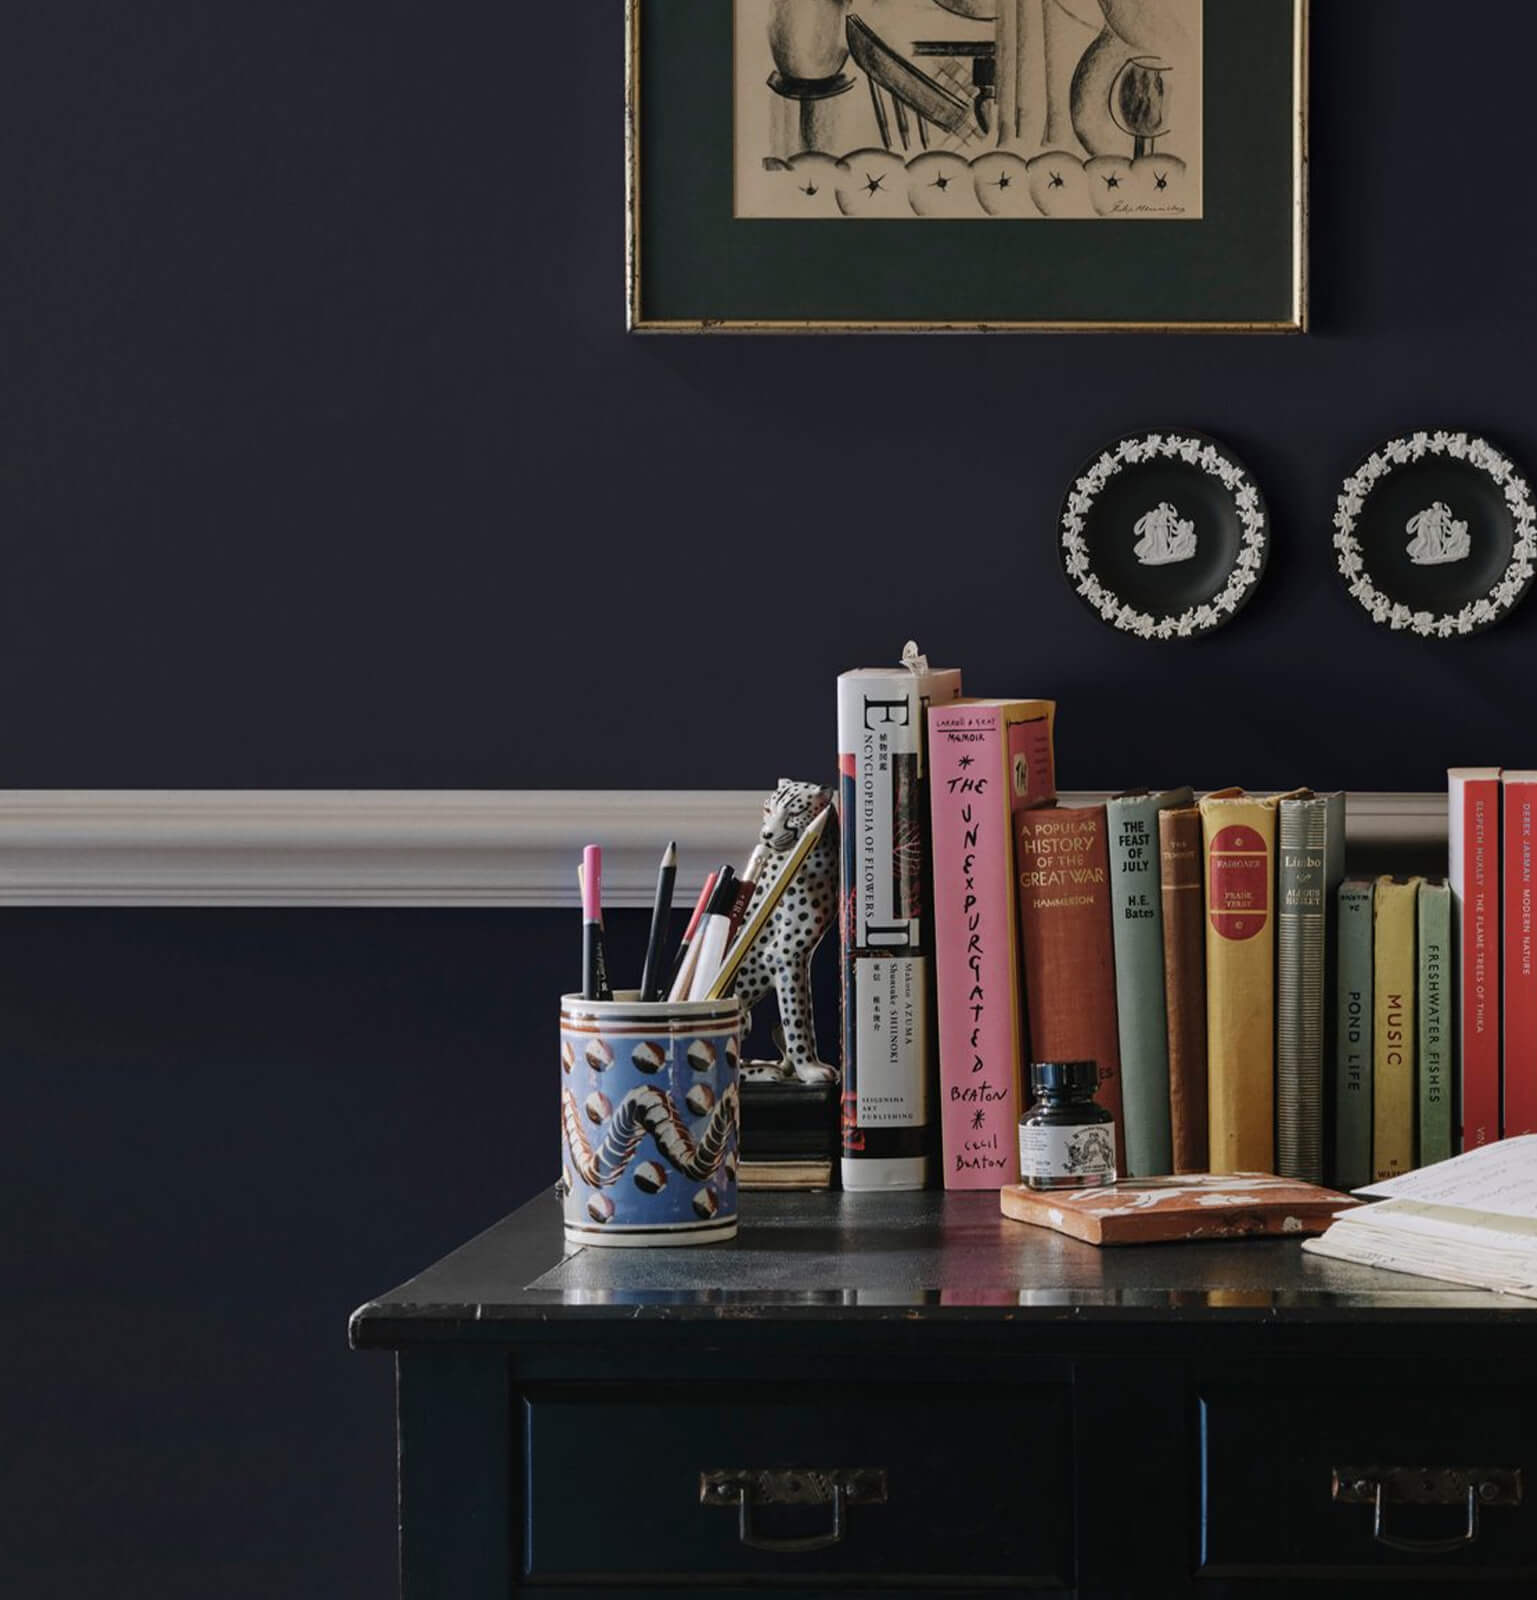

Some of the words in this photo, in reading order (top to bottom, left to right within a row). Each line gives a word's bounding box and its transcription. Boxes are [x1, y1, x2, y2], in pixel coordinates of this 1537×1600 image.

[947, 733, 985, 743] MEMOIR
[947, 777, 988, 795] THE
[1021, 825, 1032, 837] A
[1034, 821, 1097, 836] POPULAR
[1123, 821, 1145, 833] THE
[1475, 800, 1485, 843] ELSPETH
[1522, 802, 1531, 836] DEREK
[864, 836, 874, 853] OF
[1024, 836, 1095, 855] HISTORY
[1119, 833, 1151, 847] FEAST
[1127, 848, 1143, 859] OF
[1036, 856, 1053, 869] OF
[1057, 855, 1084, 867] THE
[1122, 860, 1149, 873] JULY
[1284, 855, 1321, 868] Limbo
[1475, 847, 1485, 886] HUXLEY
[1522, 840, 1531, 882] JARMAN
[864, 857, 874, 919] FLOWERS
[1020, 869, 1068, 888] GREAT
[1070, 867, 1105, 884] WAR
[1033, 895, 1095, 909] HAMMERTON
[1124, 908, 1155, 920] Bates
[1128, 894, 1150, 907] H.E.
[1475, 893, 1485, 913] THE
[1522, 888, 1531, 932] MODERN
[961, 803, 984, 1073] UNEXPURGATED
[1475, 916, 1485, 949] FLAME
[1475, 952, 1485, 983] TREES
[1522, 936, 1531, 976] NATURE
[889, 963, 898, 1006] Shunsuke
[905, 963, 913, 998] Makoto
[1428, 944, 1440, 1044] FRESHWATER
[1475, 986, 1485, 999] OF
[905, 1001, 913, 1045] AZUMA
[1348, 991, 1361, 1043] POND
[1387, 994, 1402, 1066] MUSIC
[1475, 1002, 1485, 1034] THIKA
[889, 1010, 898, 1064] SHIINOKI
[1347, 1054, 1360, 1091] LIFE
[1428, 1053, 1440, 1103] FISHES
[950, 1080, 1008, 1102] BEATON
